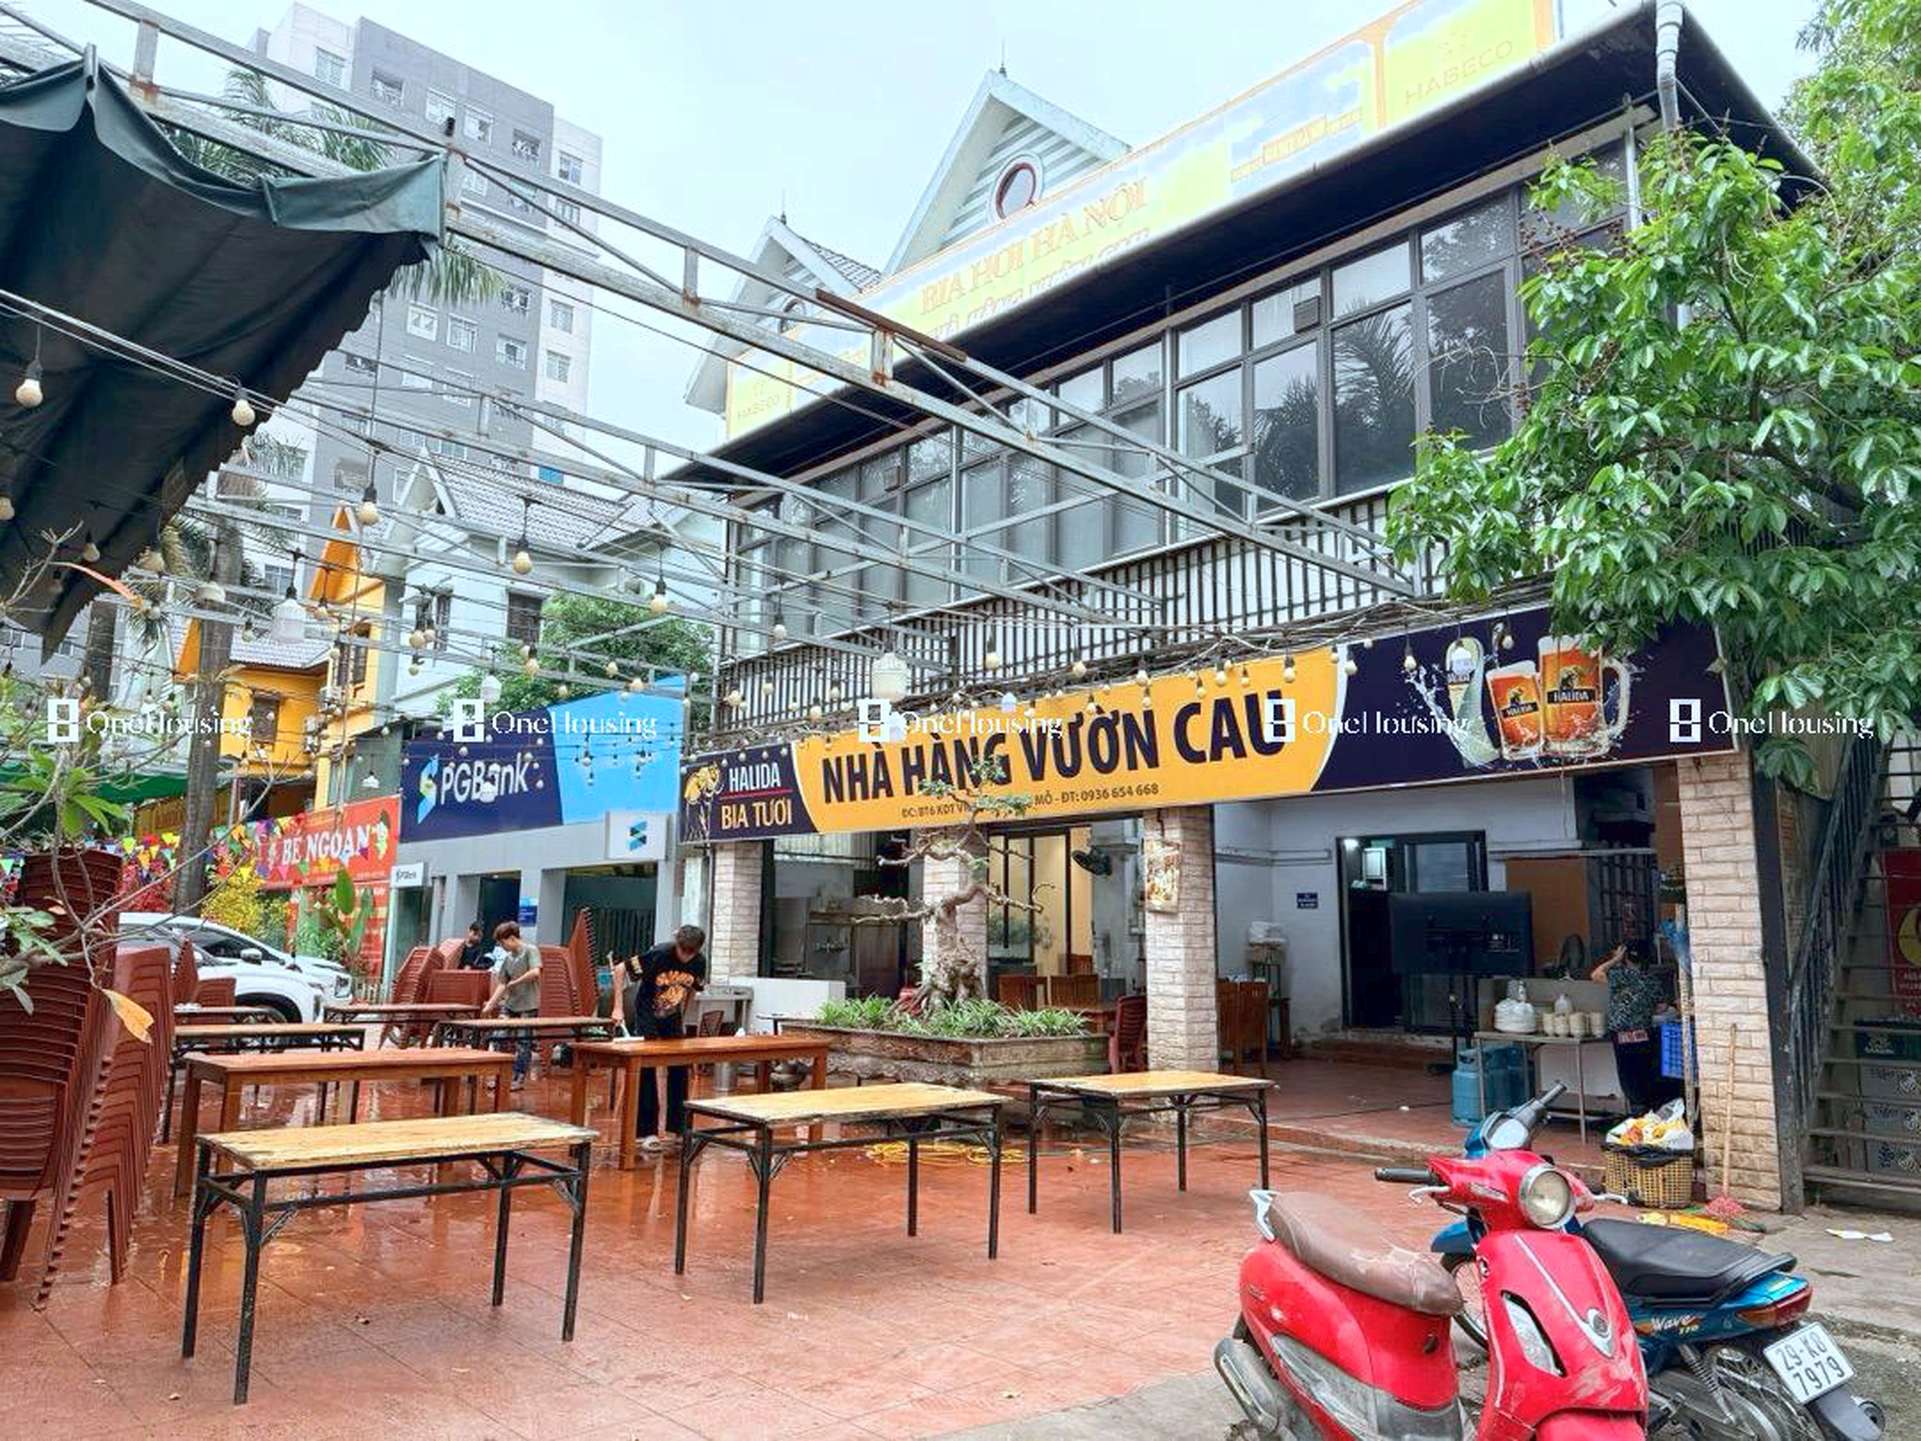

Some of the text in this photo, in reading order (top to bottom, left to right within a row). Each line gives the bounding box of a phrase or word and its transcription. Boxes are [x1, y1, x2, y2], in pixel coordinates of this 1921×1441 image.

[1405, 40, 1513, 105] HABECO
[921, 273, 965, 315] BIA
[822, 690, 1286, 804] NHÀ HÀNG VƯỜN CAU
[441, 751, 529, 805] PGBank
[728, 762, 781, 792] HALIDA
[1111, 784, 1134, 798] 654
[1136, 782, 1159, 796] 668
[721, 803, 749, 830] BIA
[1651, 1314, 1695, 1332] Wave
[1777, 1331, 1829, 1371] 29-K8
[1793, 1357, 1846, 1397] 7979
